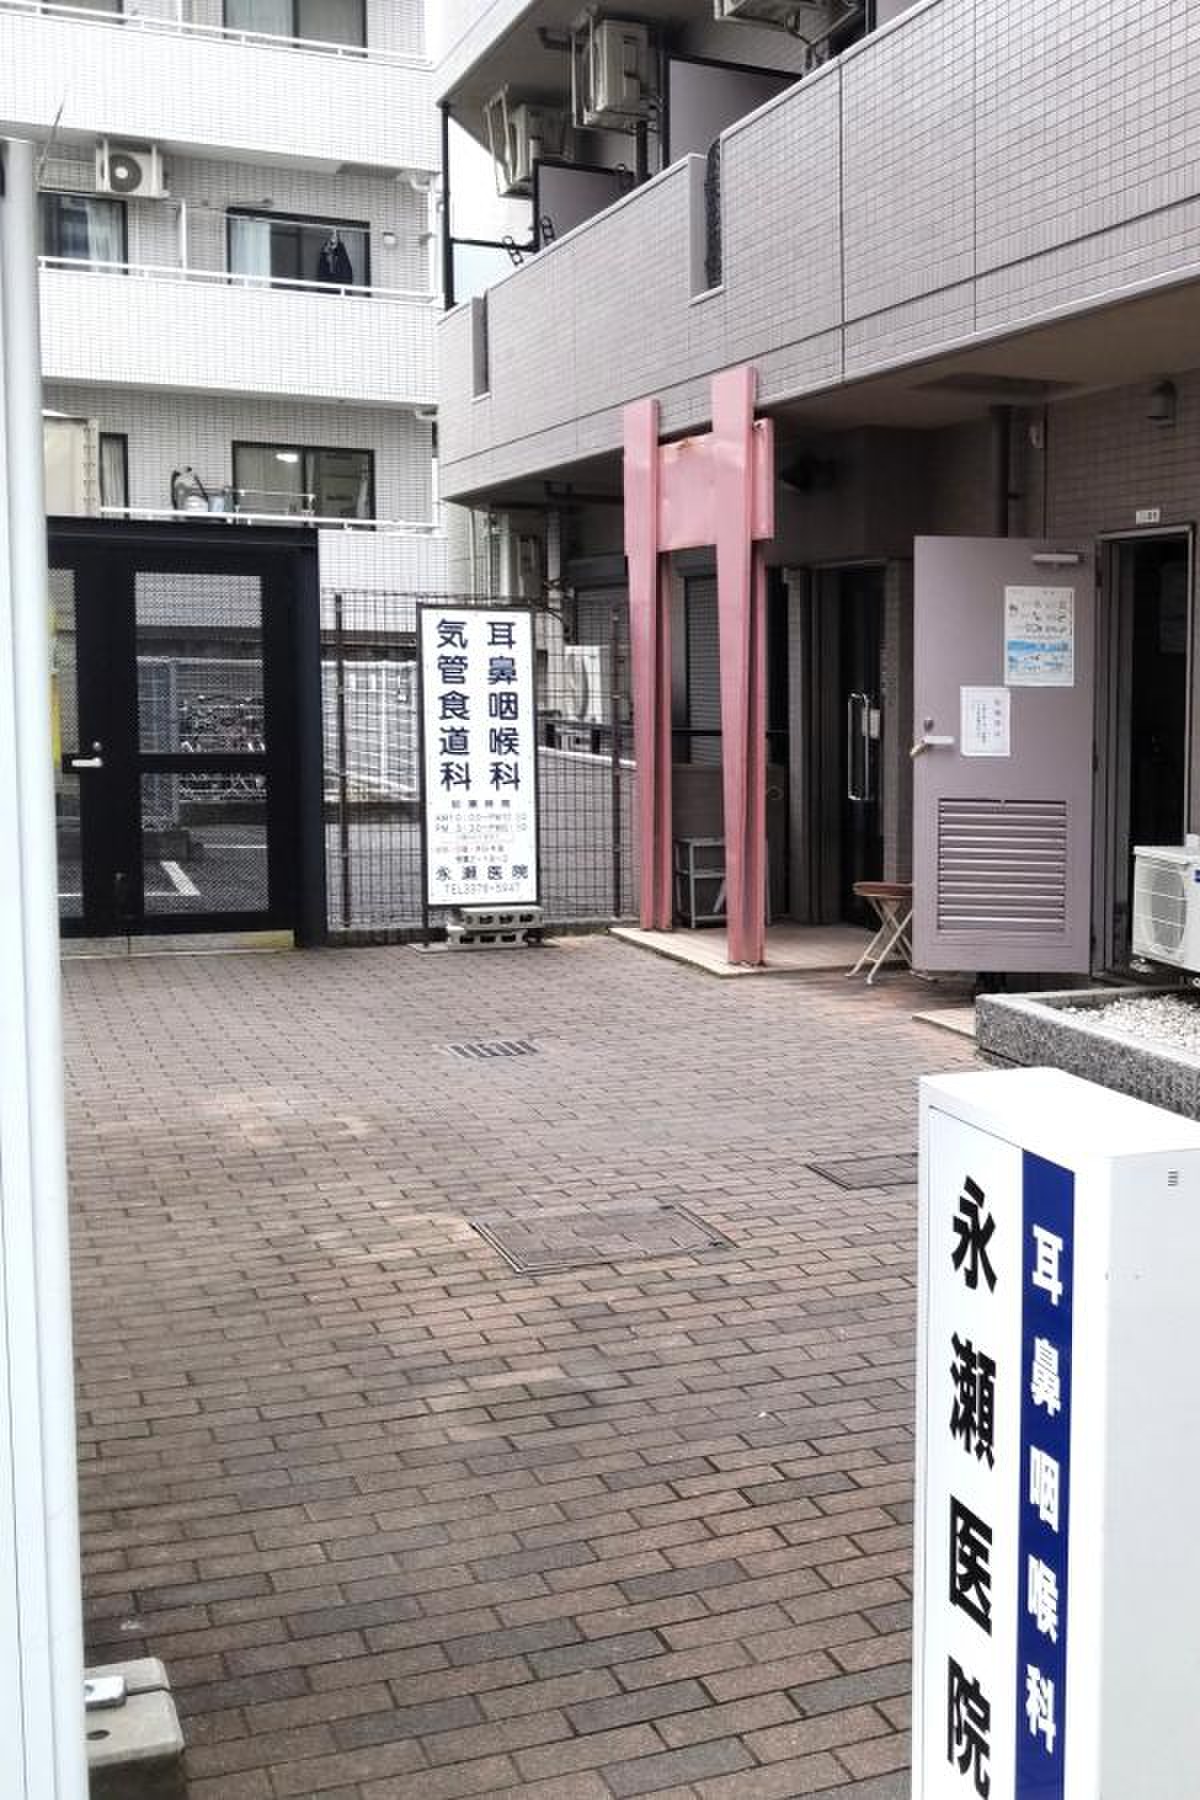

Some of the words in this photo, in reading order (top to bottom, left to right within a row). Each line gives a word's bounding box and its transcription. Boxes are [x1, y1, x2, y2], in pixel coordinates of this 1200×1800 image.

[437, 618, 472, 791] 気管食道科
[486, 621, 521, 791] 耳鼻咽喉科
[947, 1175, 997, 1800] 永瀬医院
[1024, 1223, 1062, 1754] 耳鼻咽喉科
